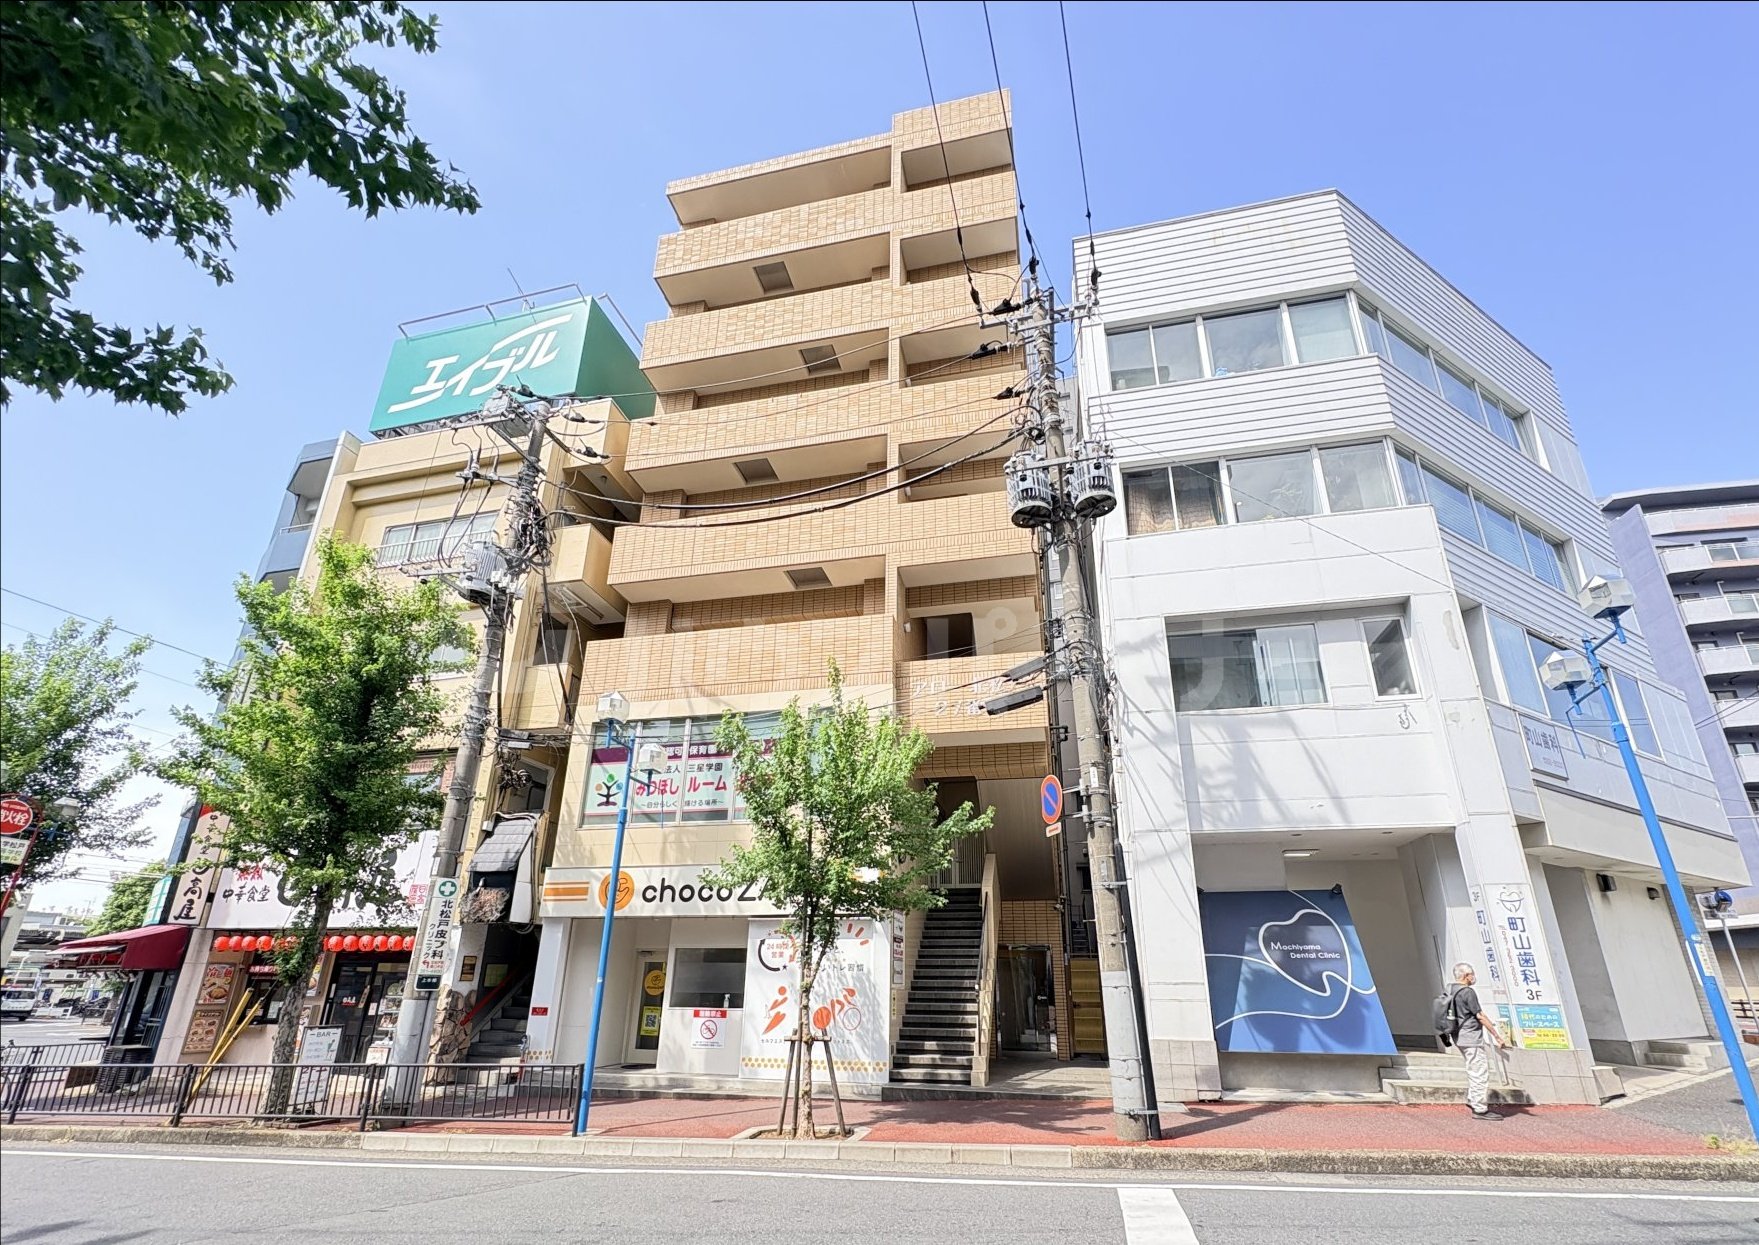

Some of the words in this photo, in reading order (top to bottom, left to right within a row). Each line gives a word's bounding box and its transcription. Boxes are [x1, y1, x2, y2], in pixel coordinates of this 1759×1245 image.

[405, 322, 562, 402] エイブル
[222, 882, 271, 903] 中華食堂
[642, 877, 768, 903] chocoZ
[423, 923, 437, 960] クリニック
[431, 899, 454, 960] 北松戸皮フ科
[1508, 916, 1541, 986] 町山歯科
[1526, 989, 1542, 1001] 3F
